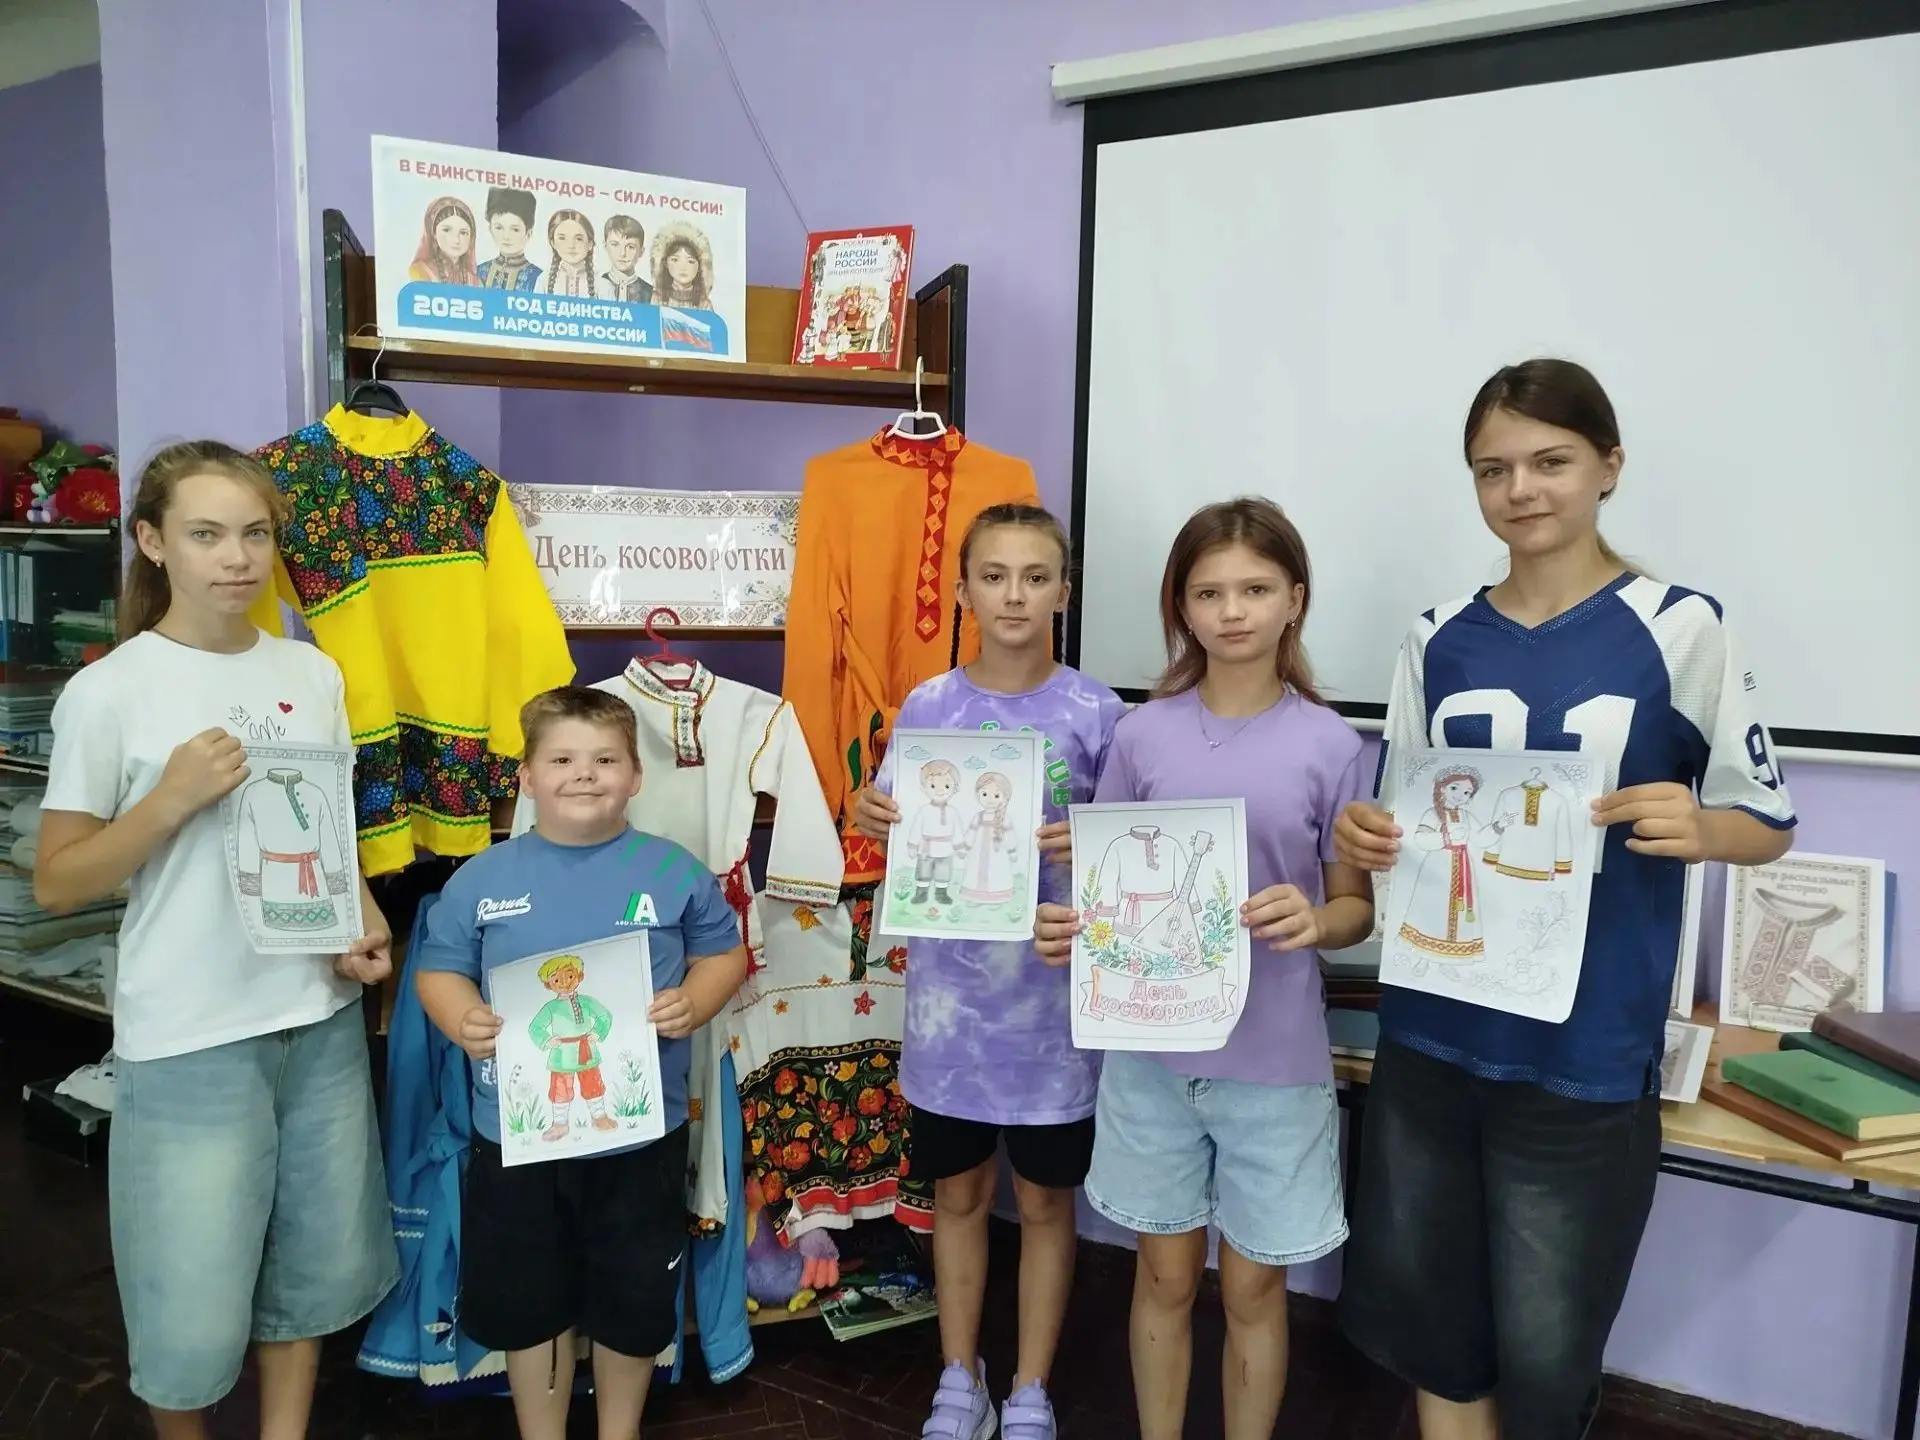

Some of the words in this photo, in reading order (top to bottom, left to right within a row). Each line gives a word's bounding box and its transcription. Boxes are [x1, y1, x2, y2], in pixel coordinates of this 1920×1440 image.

[399, 159, 411, 172] В
[416, 161, 507, 186] ЕДИНСТВЕ
[511, 174, 595, 197] НАРОДОВ
[613, 189, 656, 206] СИЛА
[660, 195, 723, 216] РОССИИ!
[834, 257, 877, 268] РОССИИ
[835, 248, 879, 259] НАРОДЫ
[412, 294, 484, 320] 2026
[506, 296, 543, 315] ГОД
[546, 300, 633, 322] ЕДИНСТВА
[493, 316, 580, 337] НАРОДОВ
[583, 326, 647, 343] РОССИИ
[618, 545, 787, 571] косоворотки
[1129, 980, 1187, 1001] День
